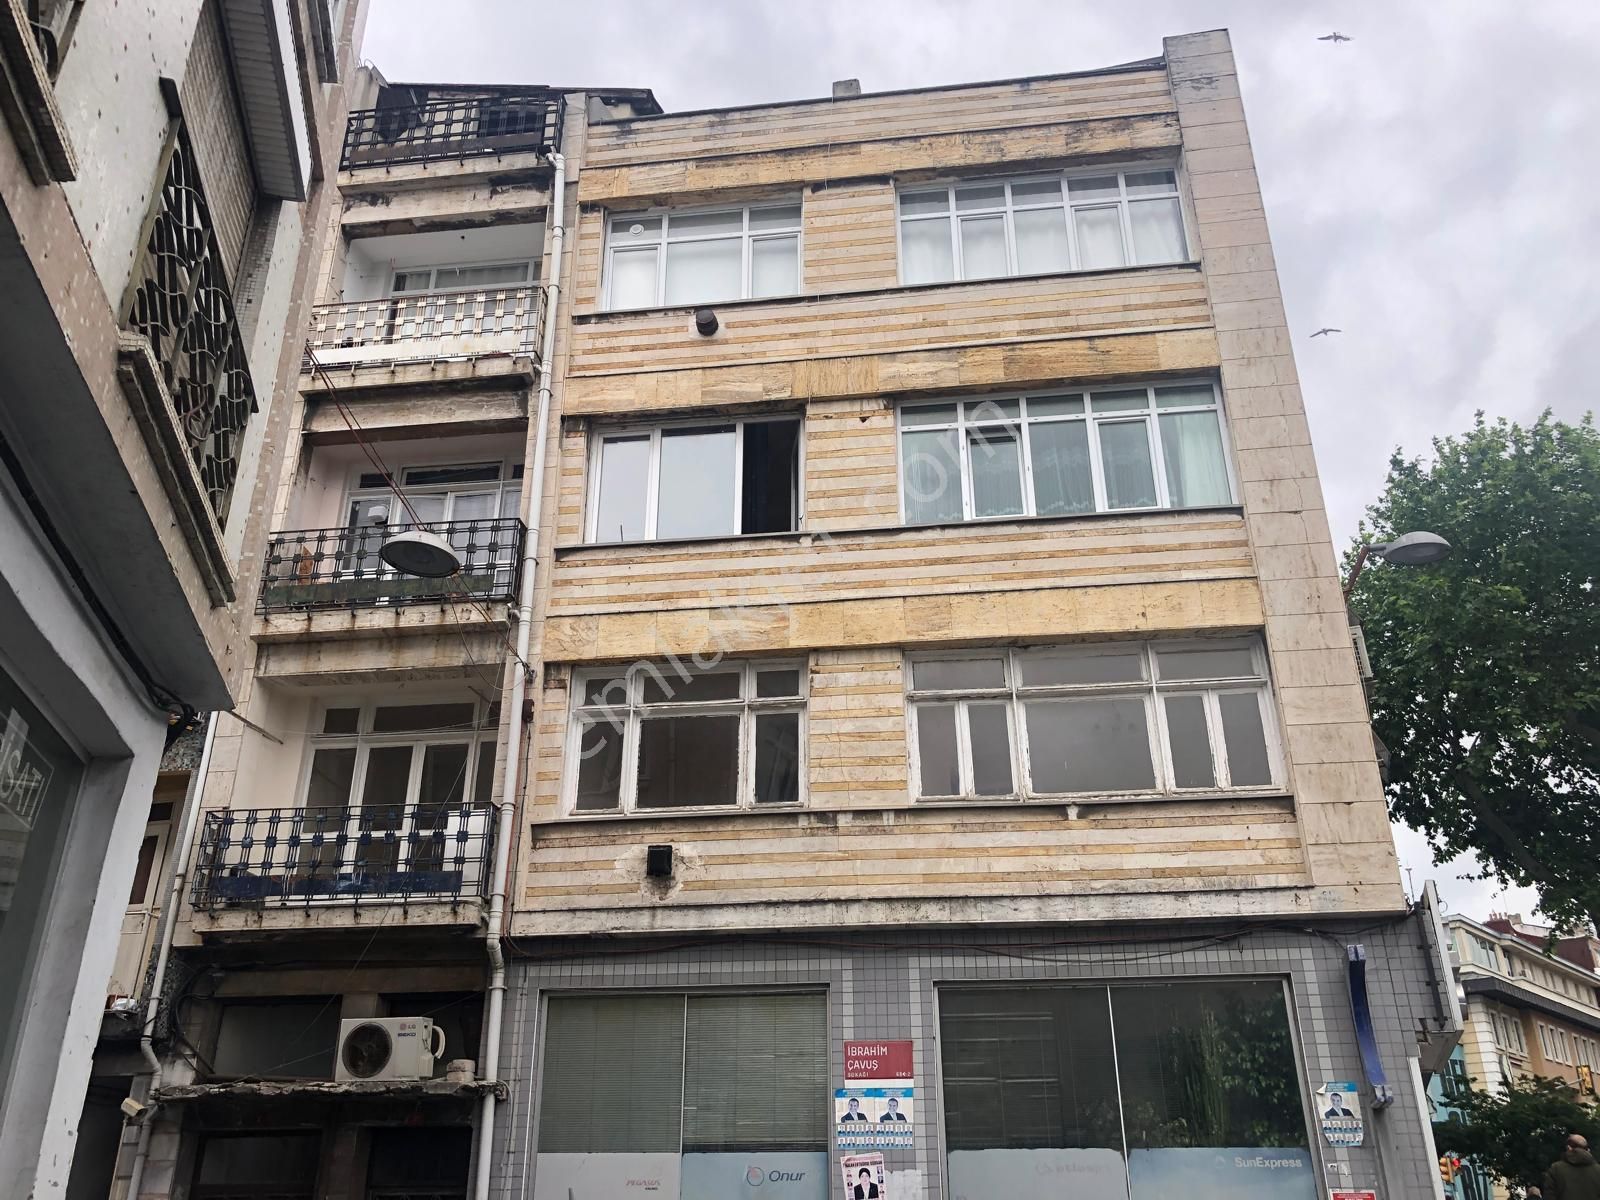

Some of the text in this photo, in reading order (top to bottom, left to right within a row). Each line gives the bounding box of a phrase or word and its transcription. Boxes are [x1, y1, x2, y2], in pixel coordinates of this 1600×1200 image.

[847, 1044, 888, 1057] İBRAHİM
[847, 1059, 879, 1071] ÇAVUŞ
[1234, 1156, 1303, 1170] SunExpress
[769, 1170, 806, 1182] Onur
